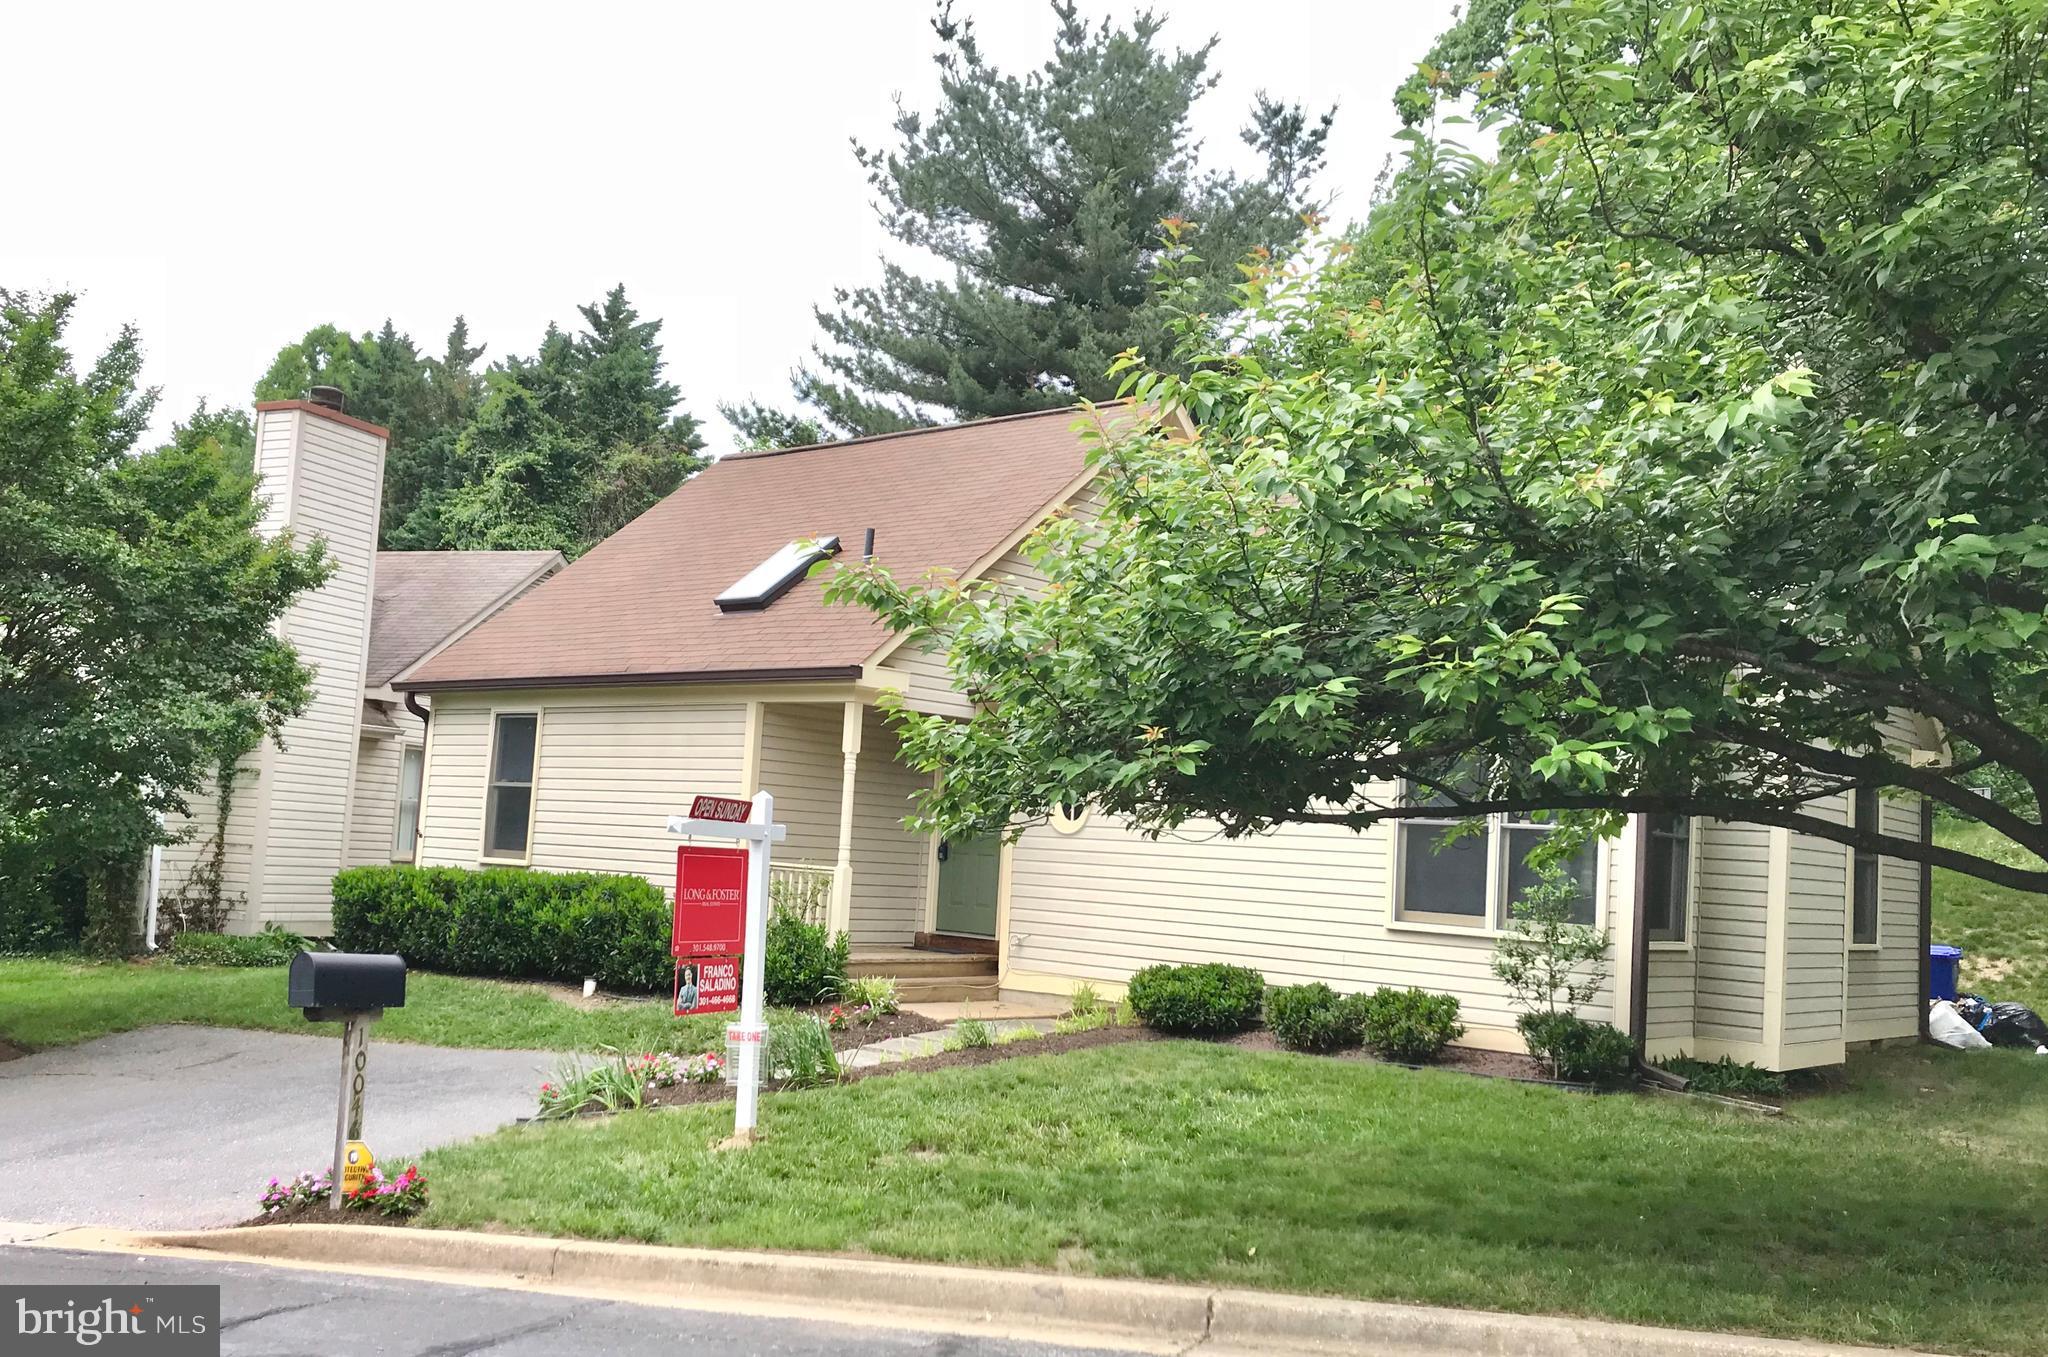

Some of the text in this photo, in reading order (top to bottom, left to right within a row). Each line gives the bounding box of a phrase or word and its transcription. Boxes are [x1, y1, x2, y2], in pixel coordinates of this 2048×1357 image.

[694, 798, 748, 821] OPEN SUNDAY
[703, 964, 734, 978] FRANCO
[699, 977, 737, 992] SALADINO
[729, 1031, 761, 1042] TAKE ONE
